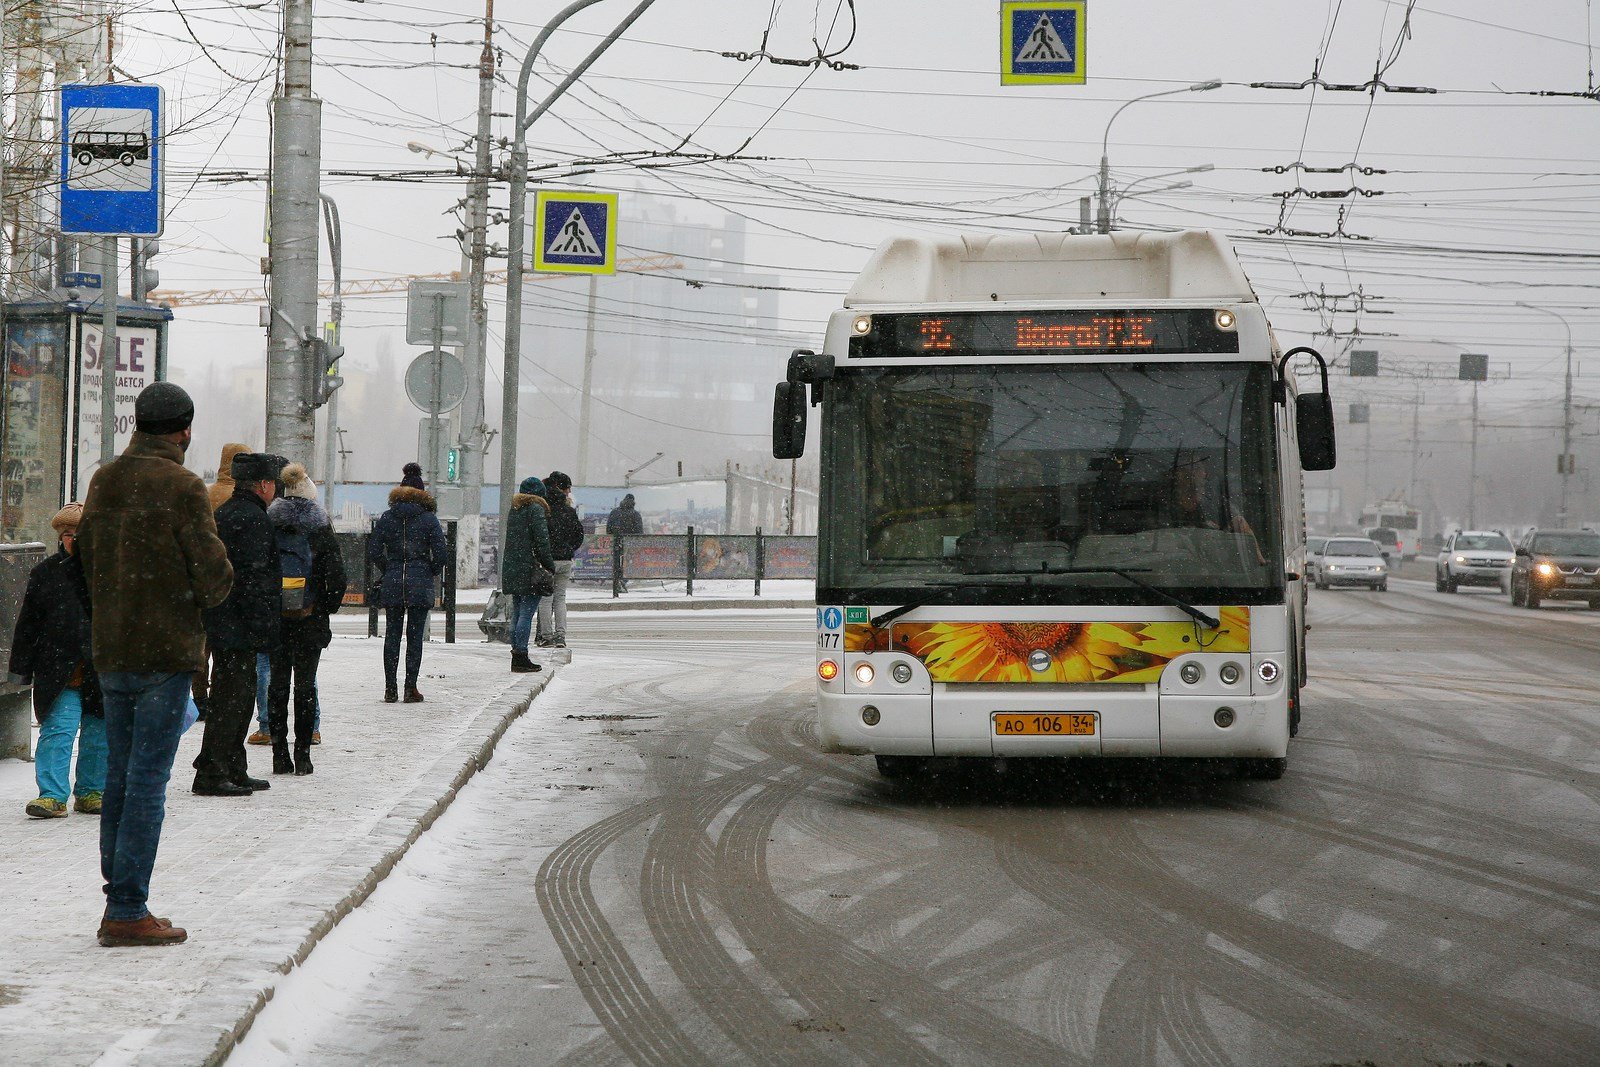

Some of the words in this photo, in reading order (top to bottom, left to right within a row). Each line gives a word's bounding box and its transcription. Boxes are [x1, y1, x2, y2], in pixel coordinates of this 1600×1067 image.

[82, 374, 144, 388] ПРОДОАЕТСЯ
[1033, 716, 1062, 732] 106
[1072, 716, 1089, 728] 34
